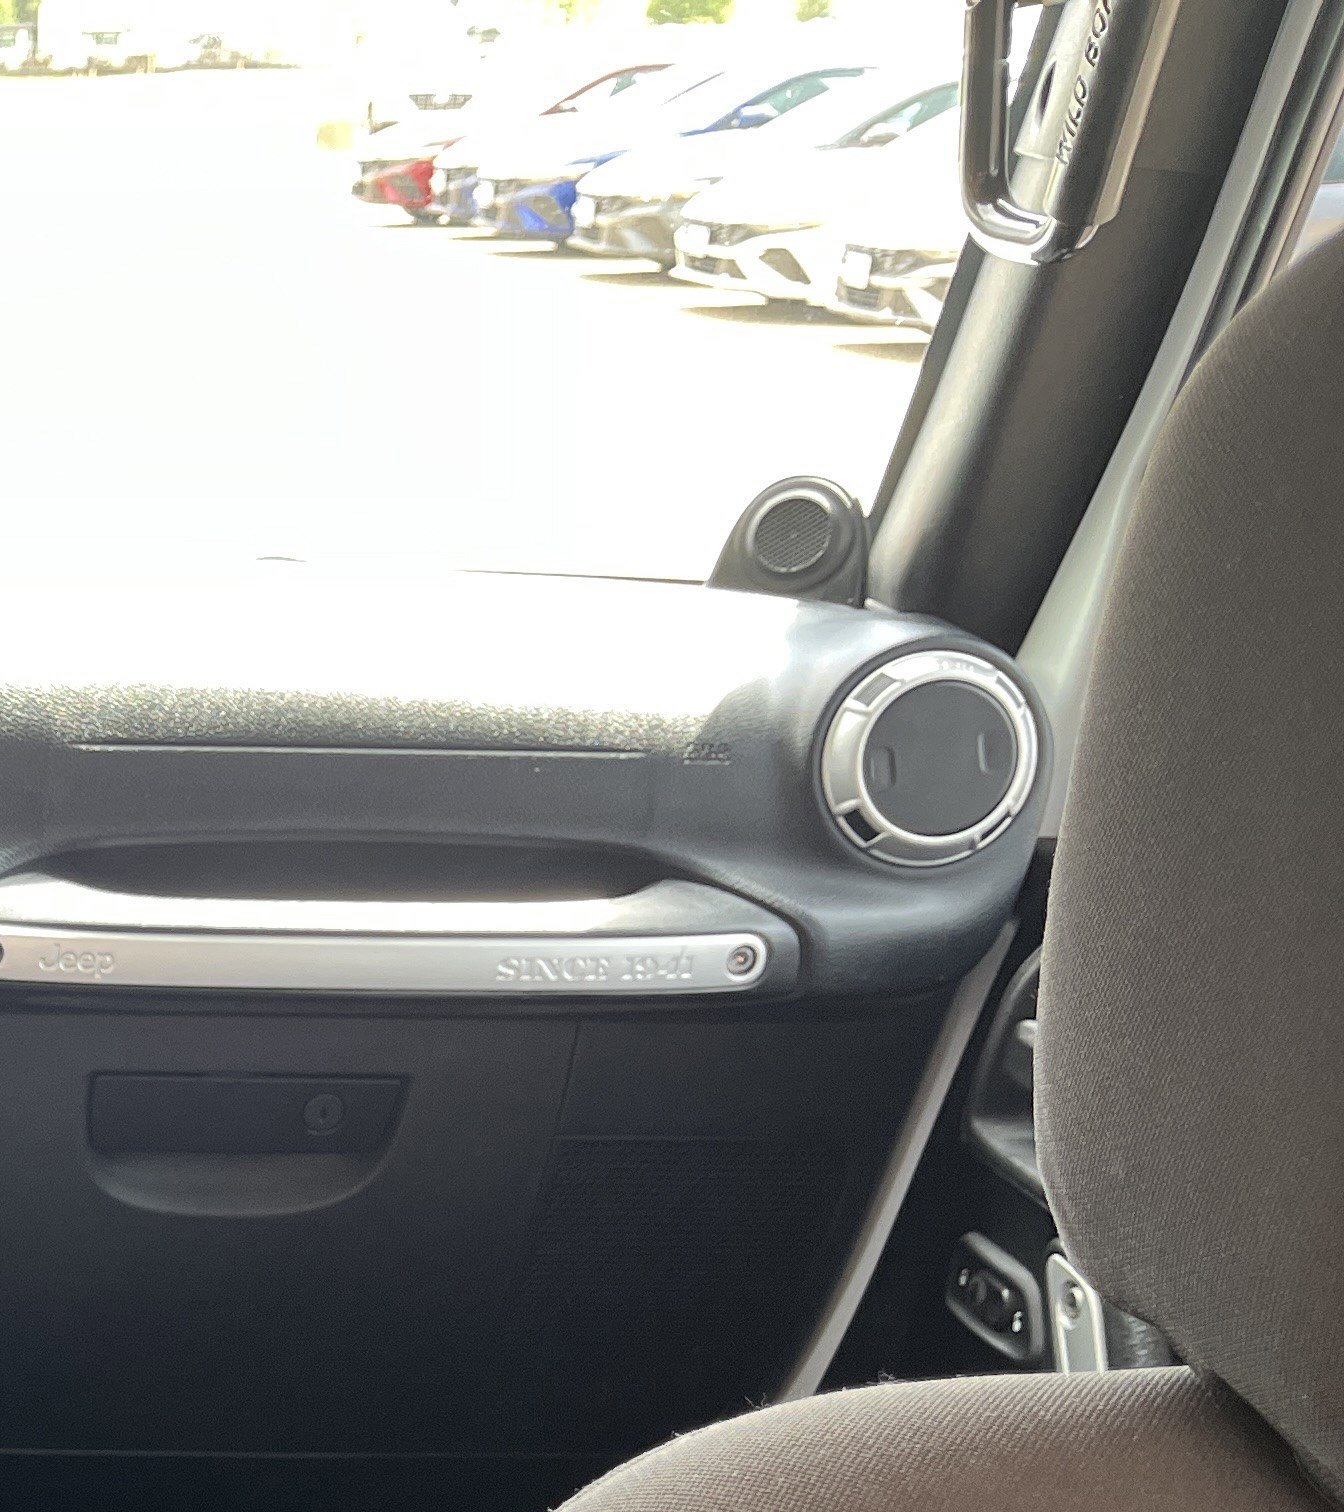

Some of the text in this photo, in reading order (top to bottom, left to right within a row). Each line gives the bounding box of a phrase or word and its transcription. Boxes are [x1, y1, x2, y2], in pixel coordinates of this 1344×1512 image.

[1055, 74, 1088, 165] WILD
[38, 943, 115, 980] Jeep
[496, 951, 695, 982] SINCE 1941
